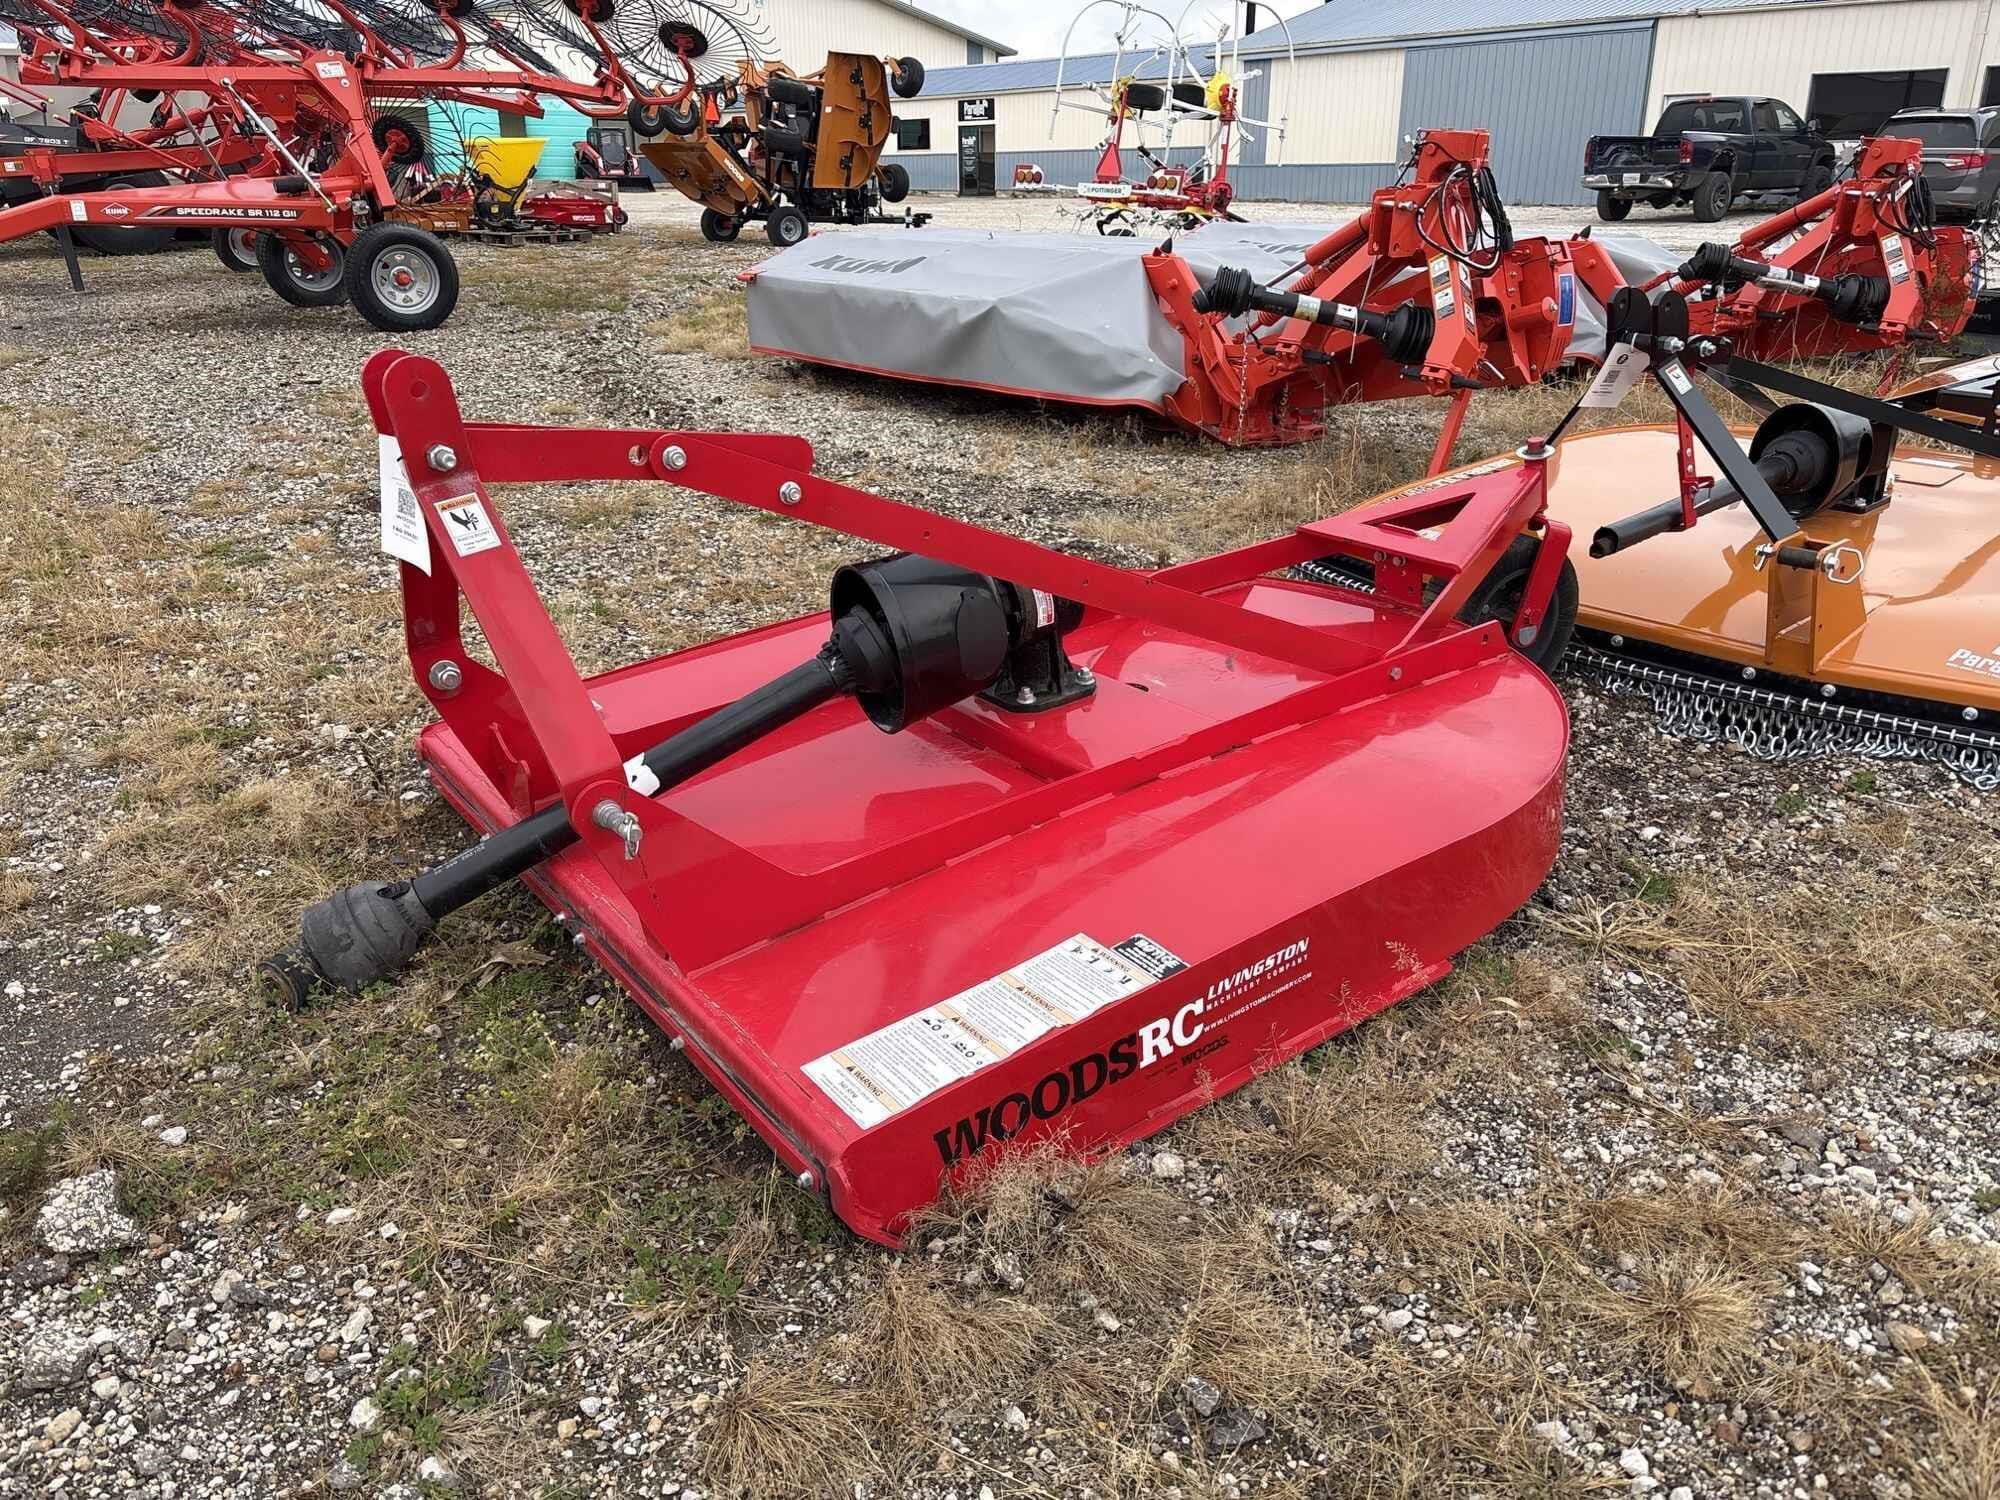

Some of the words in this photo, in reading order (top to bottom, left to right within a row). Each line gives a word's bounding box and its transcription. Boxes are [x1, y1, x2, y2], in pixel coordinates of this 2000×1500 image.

[176, 207, 245, 217] SPEEDRAKE
[247, 209, 263, 217] SR
[264, 209, 281, 217] 112
[808, 254, 928, 274] KUHN
[1099, 951, 1131, 974] WARNING
[1135, 939, 1181, 969] NOTICE
[1207, 937, 1310, 1001] LIVINGSTON
[1206, 979, 1261, 1012] MACHINERY
[1266, 953, 1310, 981] COMPANY
[1024, 989, 1056, 1013] WARNING
[1203, 971, 1313, 1034] WWW.LIVINGSTONMACHINERY.COM
[958, 1020, 990, 1045] WARNING
[853, 1070, 884, 1098] WARNING
